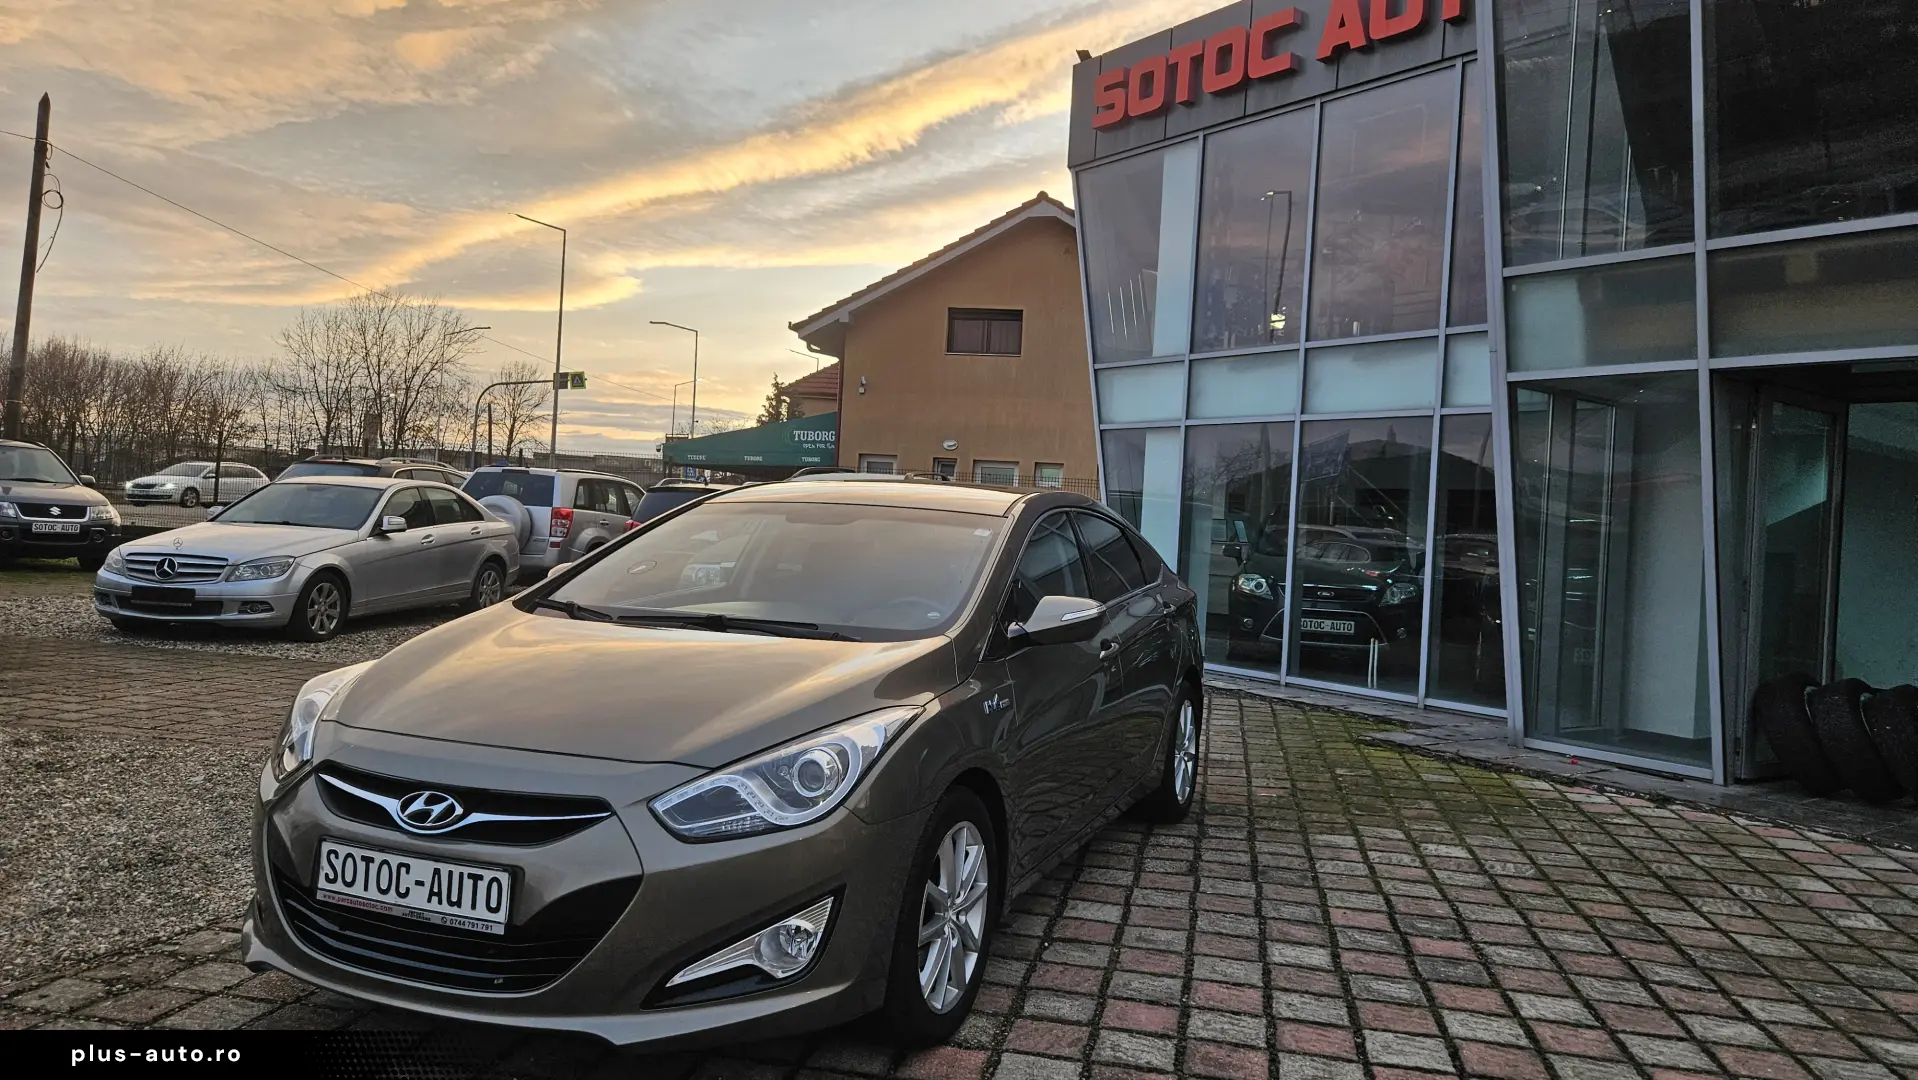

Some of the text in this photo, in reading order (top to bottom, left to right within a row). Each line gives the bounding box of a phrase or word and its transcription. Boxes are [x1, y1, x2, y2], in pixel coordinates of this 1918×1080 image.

[1092, 6, 1300, 131] SOTOC
[793, 430, 836, 441] TUBORG
[1300, 619, 1353, 632] OTOC-AUTO
[324, 849, 503, 914] SOTOC-AUTO
[449, 918, 466, 927] 0744
[467, 921, 479, 929] 791
